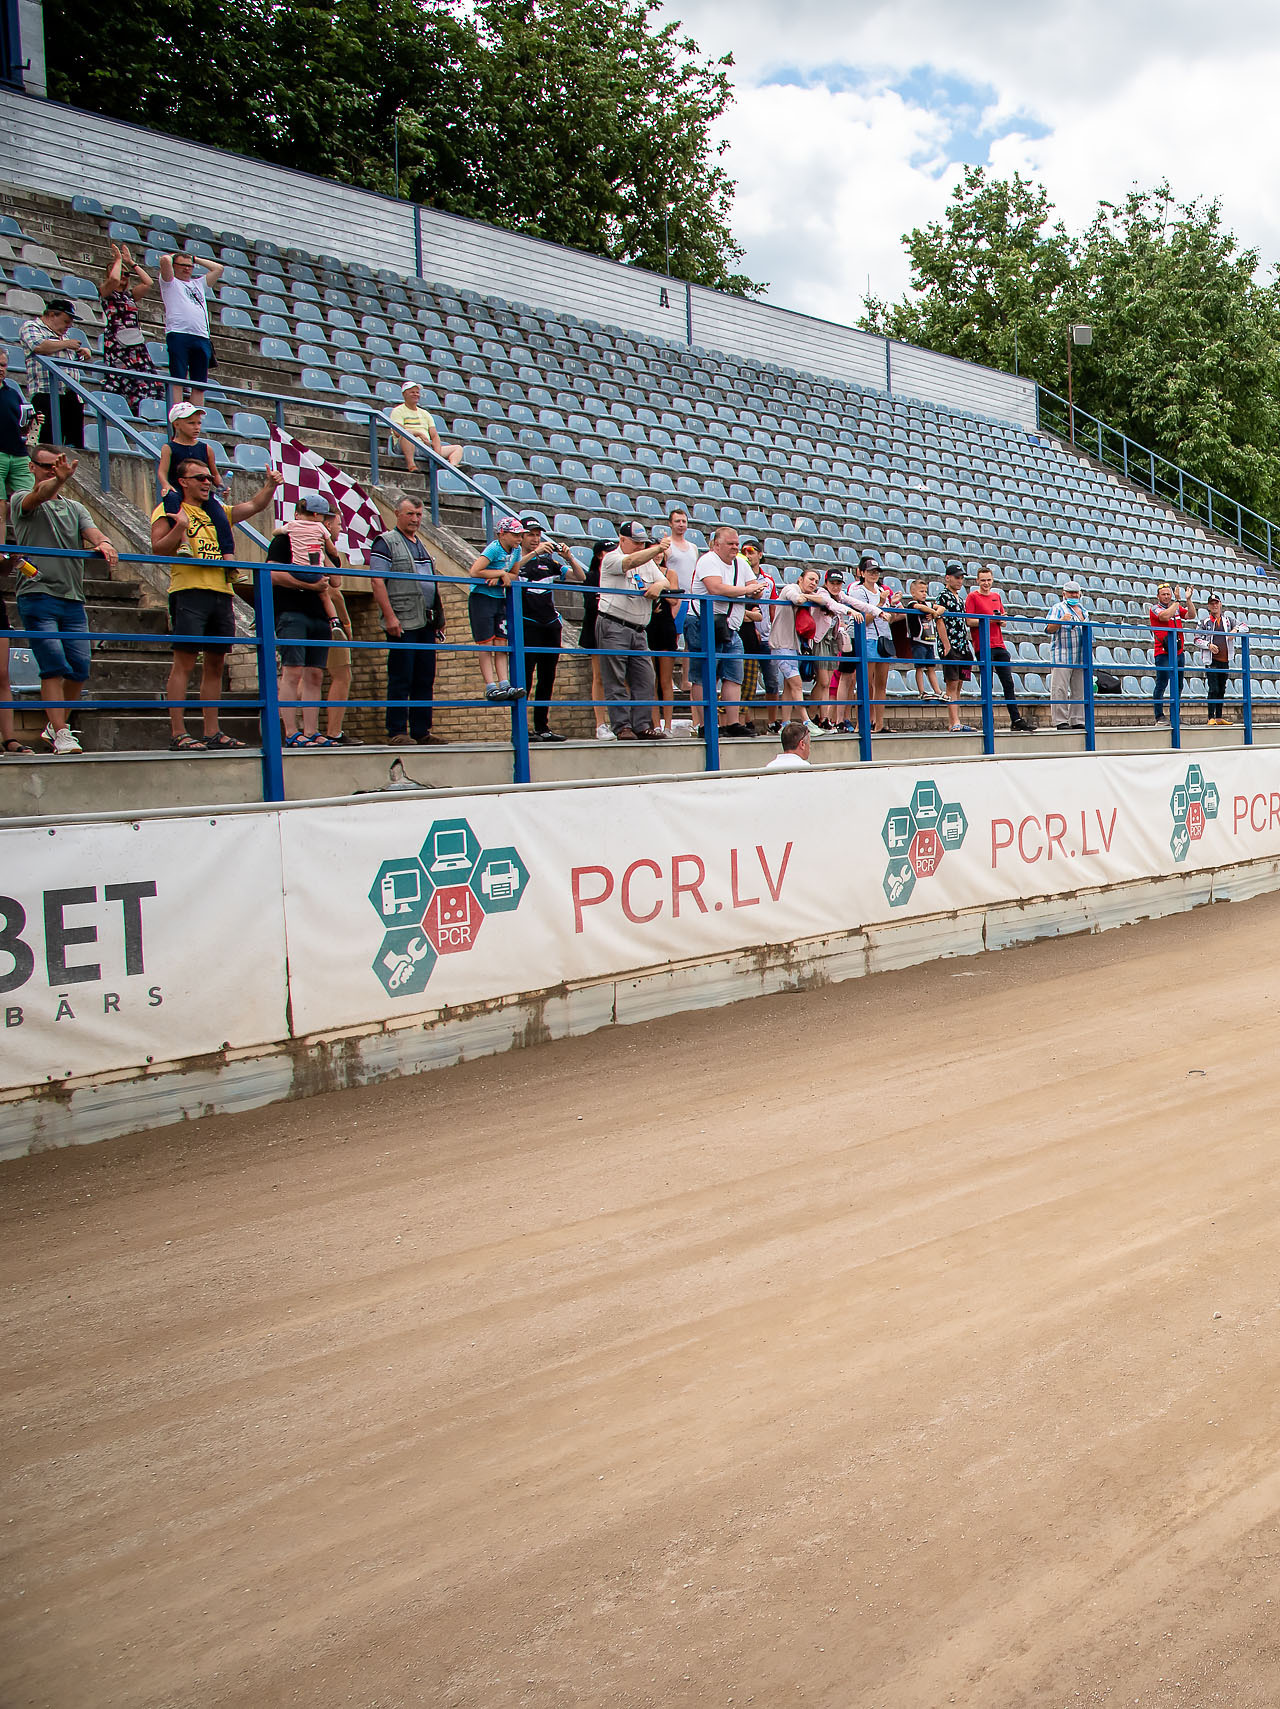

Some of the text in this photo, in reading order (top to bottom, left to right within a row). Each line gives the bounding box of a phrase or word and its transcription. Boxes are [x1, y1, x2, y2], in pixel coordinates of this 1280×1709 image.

[13, 651, 29, 662] 45
[990, 807, 1118, 870] PCR.LV
[915, 857, 936, 873] PCR
[570, 841, 794, 934] PCR.LV
[437, 925, 472, 949] PCR
